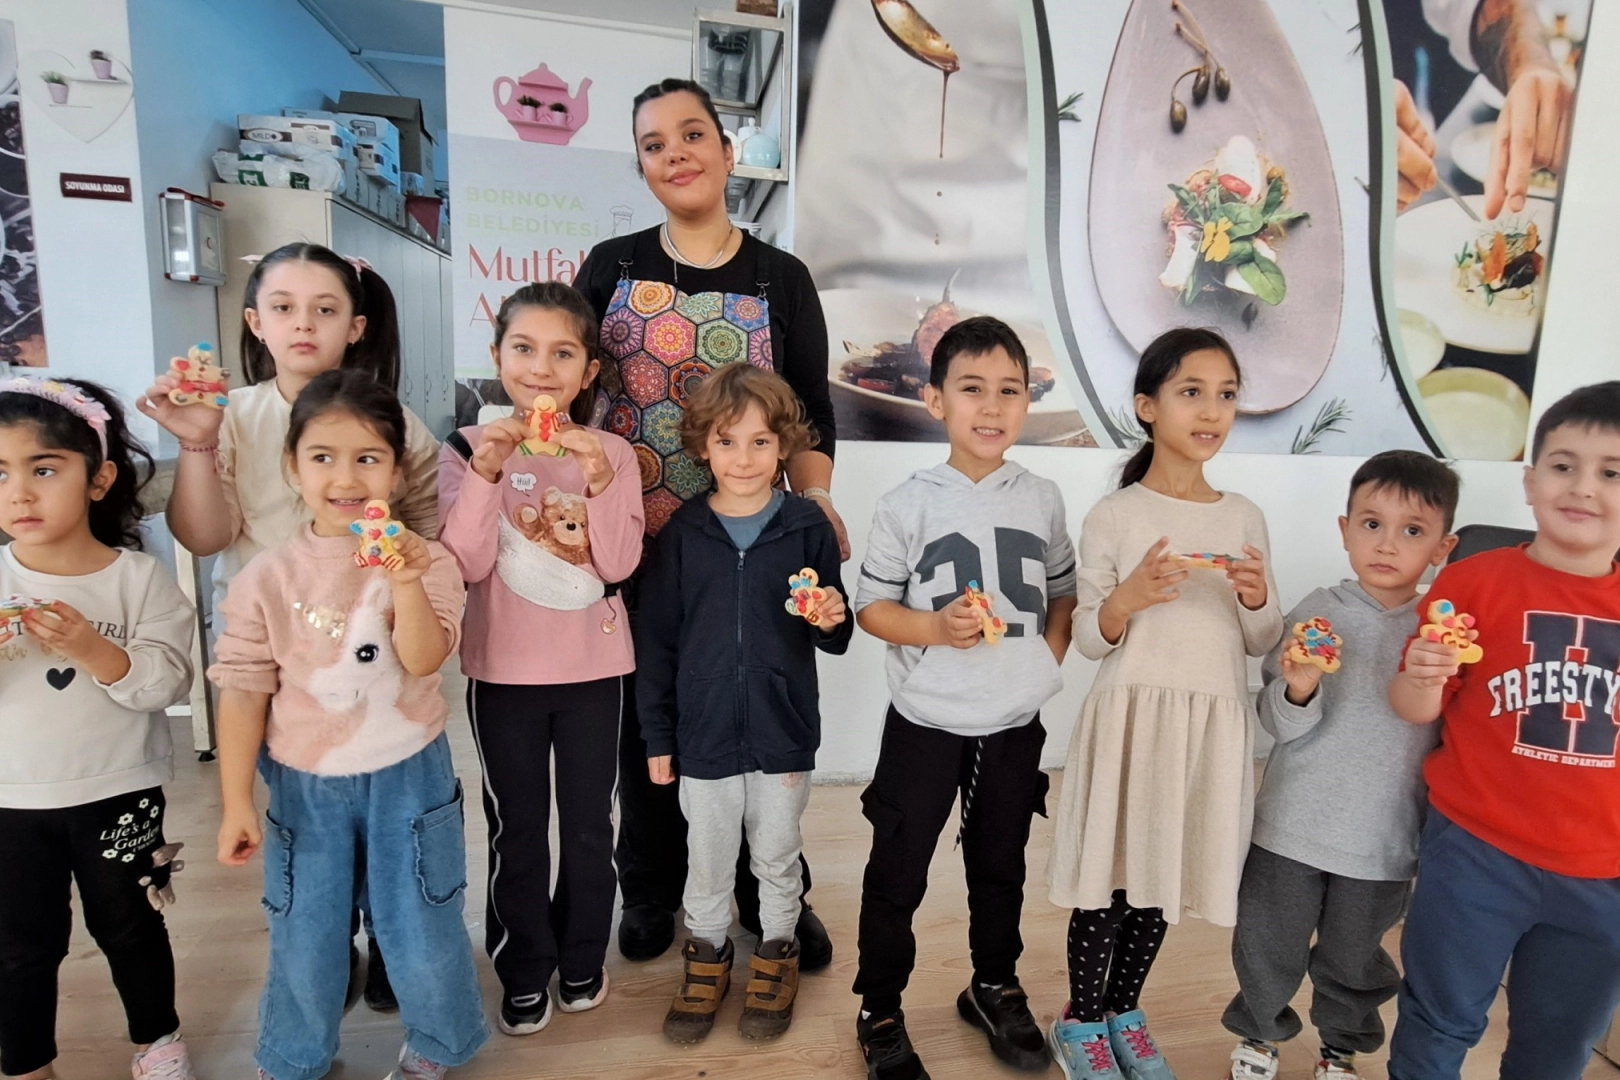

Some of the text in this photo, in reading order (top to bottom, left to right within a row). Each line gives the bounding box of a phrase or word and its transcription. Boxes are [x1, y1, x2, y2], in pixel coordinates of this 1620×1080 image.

[65, 181, 125, 193] SOYUNMA ODASI
[467, 186, 584, 211] BORNOVA
[467, 213, 600, 238] BELEDİYESİ
[142, 820, 150, 829] a
